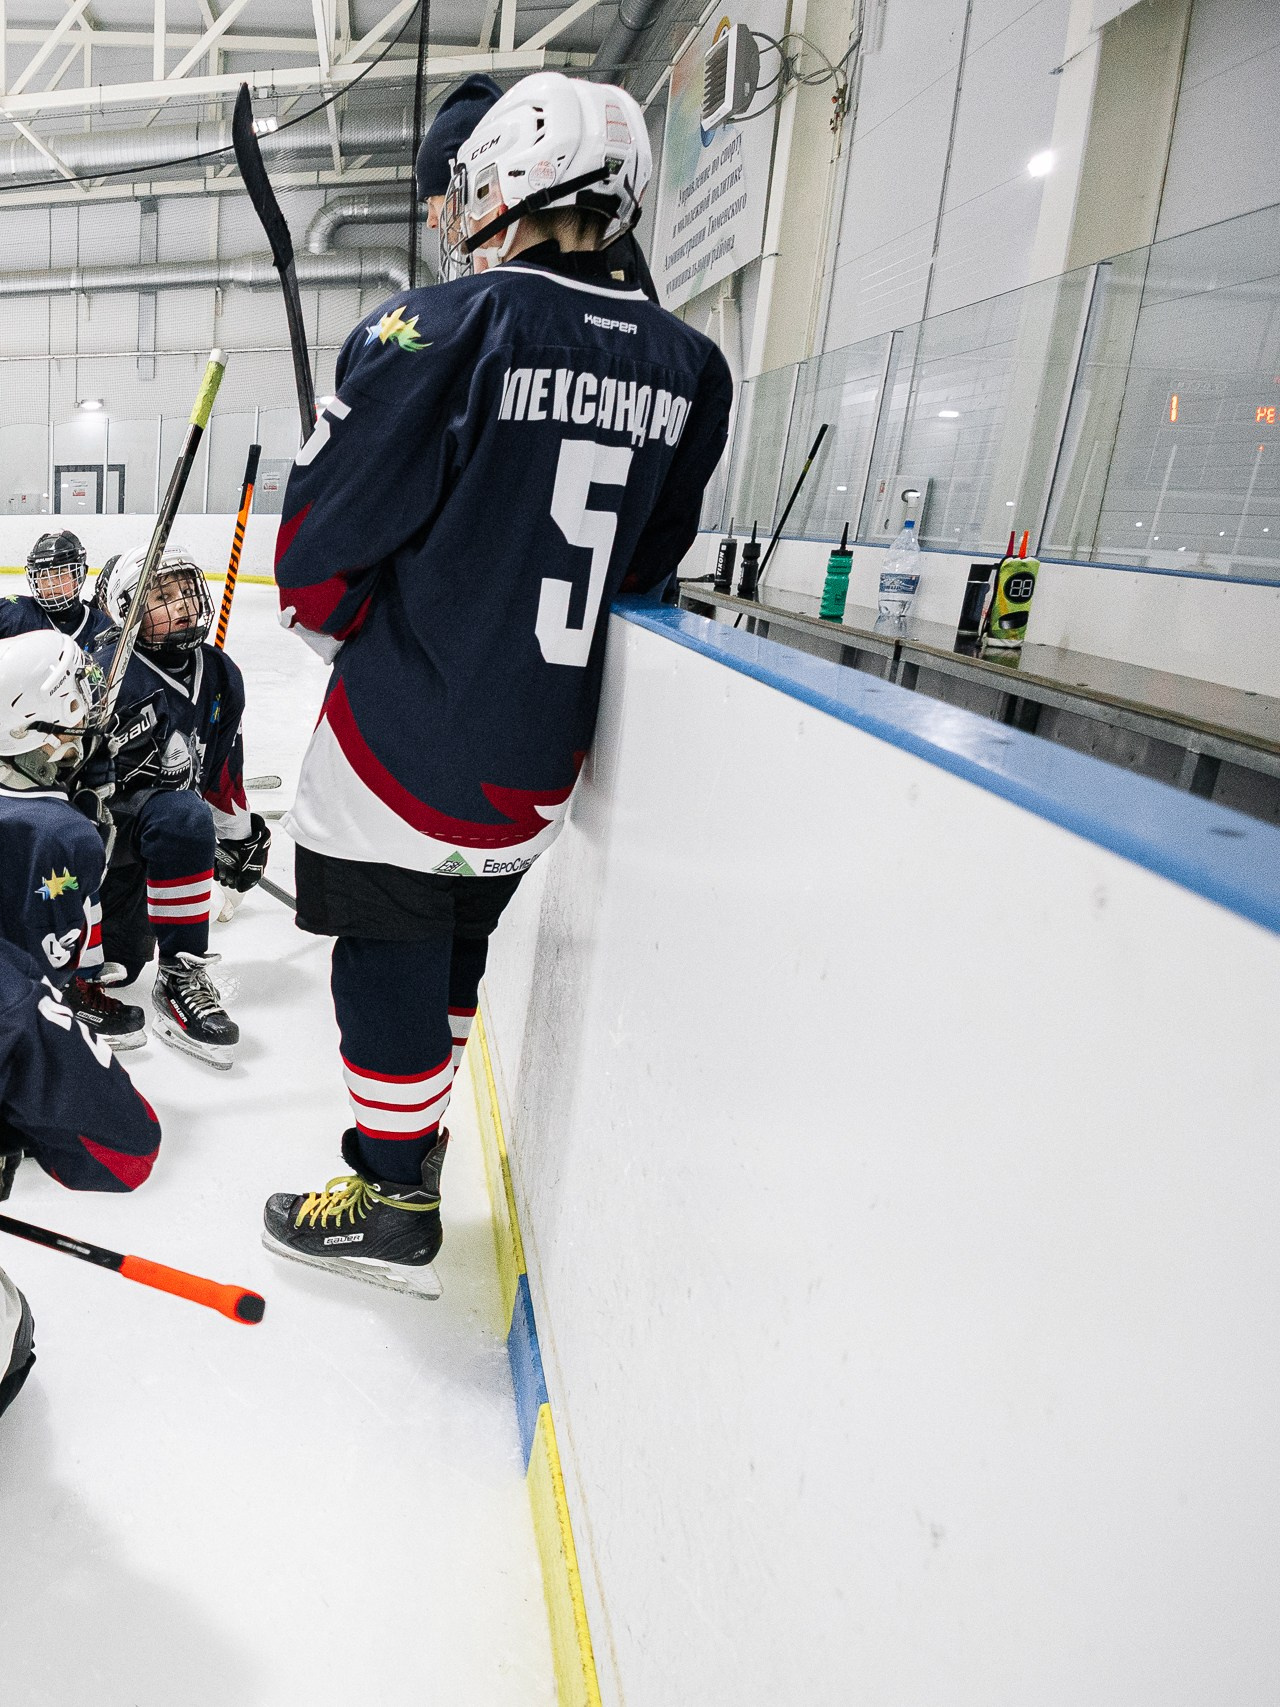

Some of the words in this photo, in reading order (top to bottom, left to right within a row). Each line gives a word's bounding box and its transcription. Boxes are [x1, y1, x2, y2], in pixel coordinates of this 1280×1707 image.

[471, 135, 501, 160] CCM
[534, 438, 635, 667] 5
[49, 675, 68, 698] BAUER
[170, 998, 188, 1023] BAUER
[326, 1234, 362, 1244] BAUER
